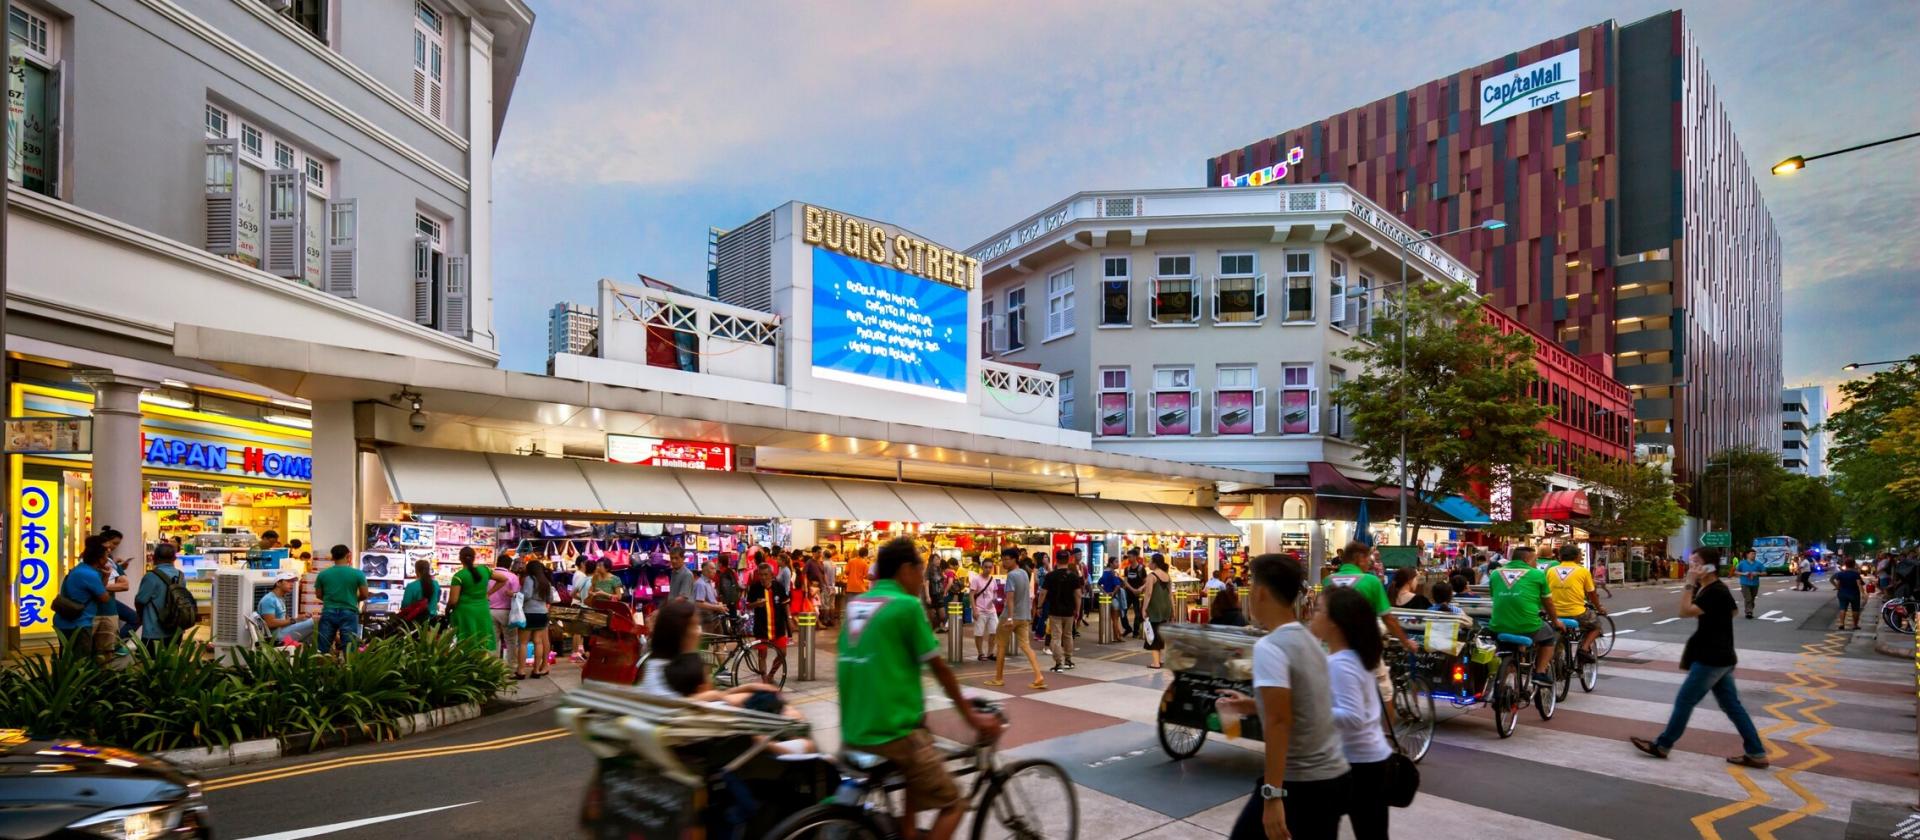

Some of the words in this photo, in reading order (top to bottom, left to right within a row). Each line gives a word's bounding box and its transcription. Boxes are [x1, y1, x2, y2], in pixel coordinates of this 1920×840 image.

[1484, 62, 1561, 103] CapitaMall
[1528, 91, 1560, 107] Trust
[239, 241, 254, 252] are
[803, 204, 887, 263] BUGIS
[893, 234, 978, 290] STREET
[141, 432, 227, 471] APAN
[180, 491, 201, 503] SUPER
